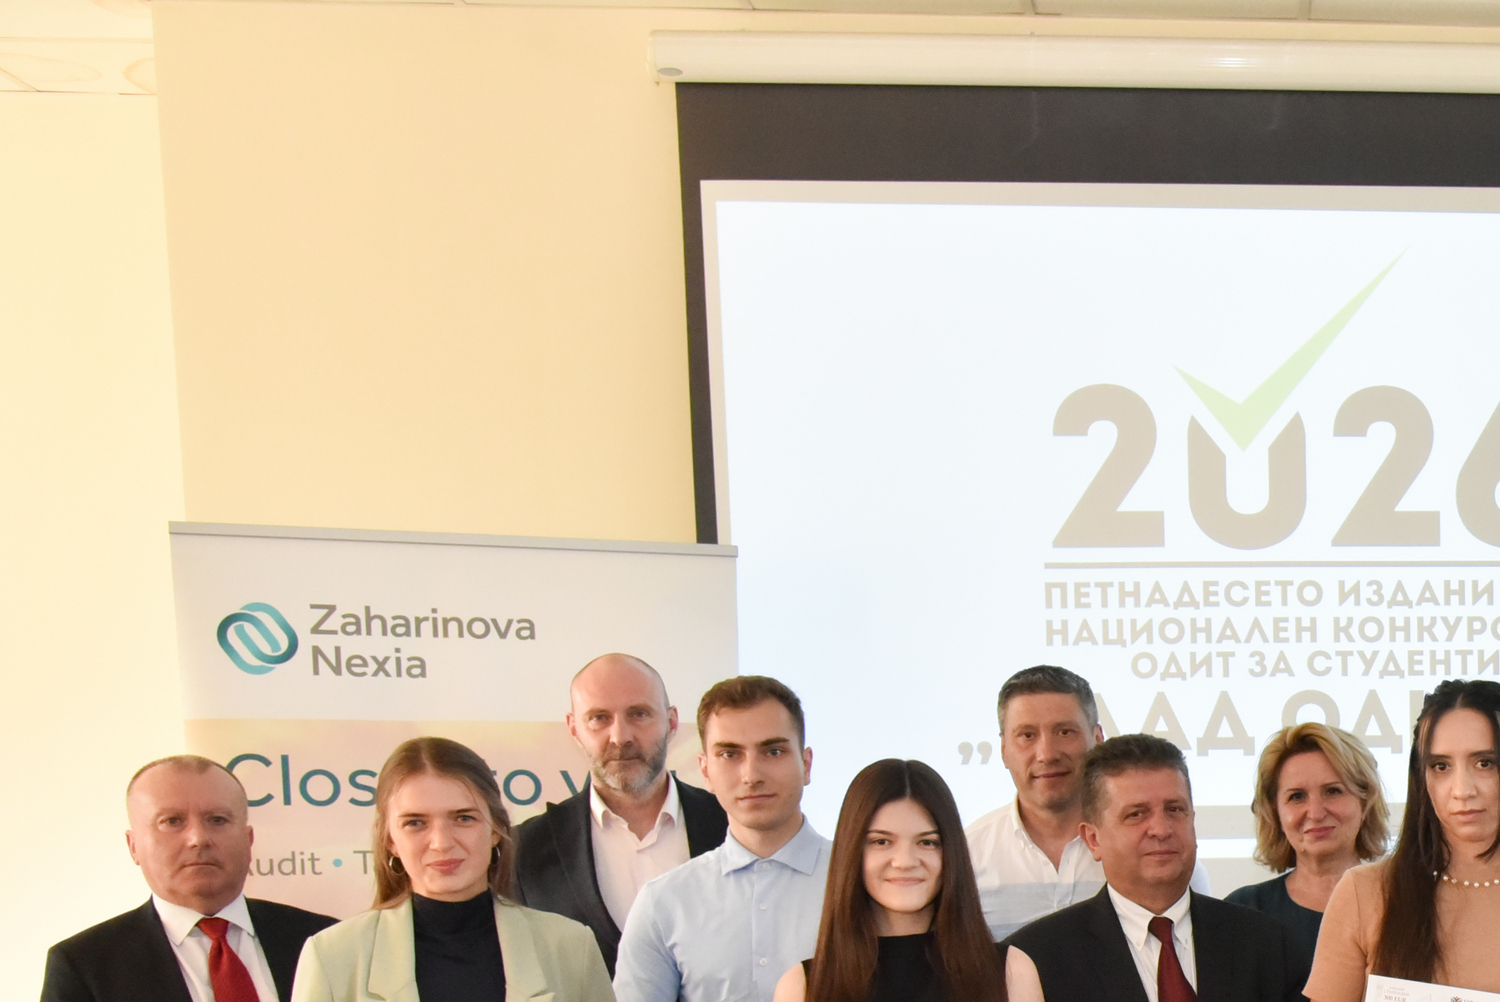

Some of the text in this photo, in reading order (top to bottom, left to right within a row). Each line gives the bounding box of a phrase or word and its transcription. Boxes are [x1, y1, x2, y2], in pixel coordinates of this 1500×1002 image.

[1045, 579, 1323, 610] ПЕТНАДЕСЕТО
[309, 603, 537, 641] Zaharinova
[1045, 616, 1317, 648] НАЦИОНАЛЕН
[311, 645, 428, 679] Nexia
[1131, 649, 1500, 681] ОДИТ ЗА СТУДЕНТИ
[226, 753, 378, 807] Clos
[249, 850, 323, 876] udit
